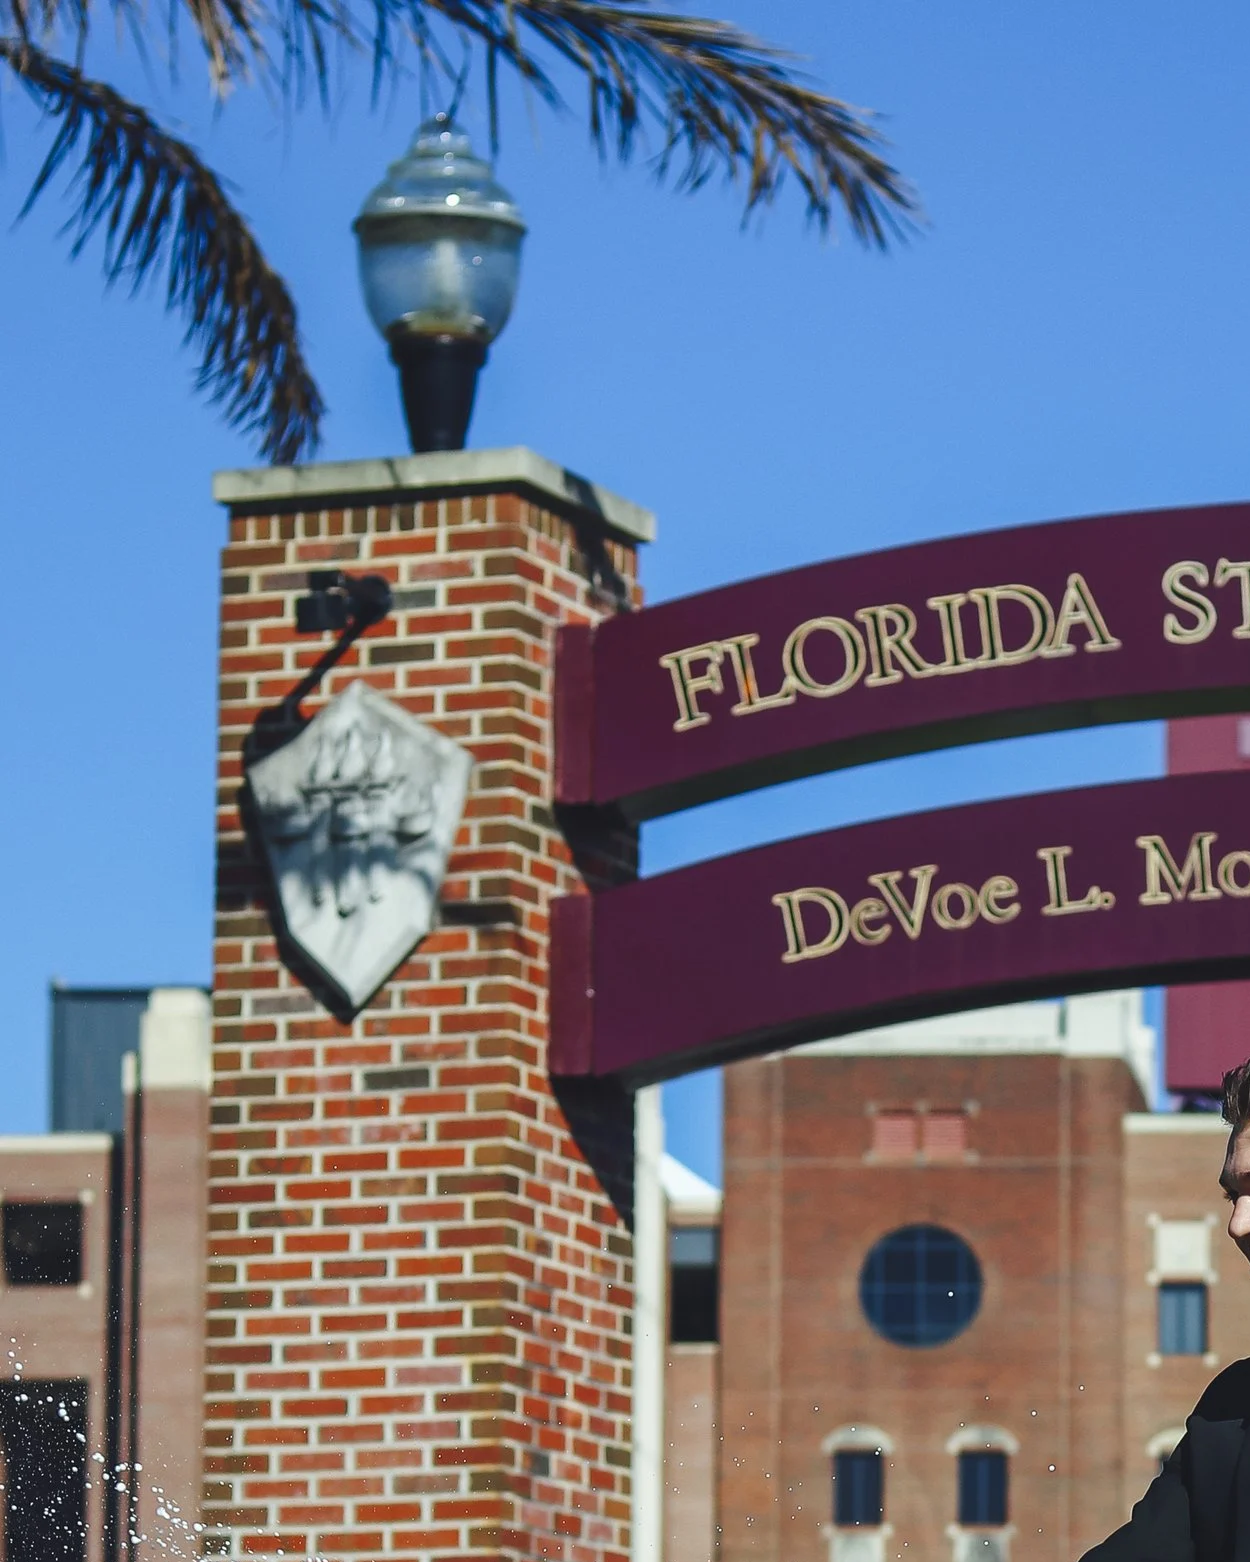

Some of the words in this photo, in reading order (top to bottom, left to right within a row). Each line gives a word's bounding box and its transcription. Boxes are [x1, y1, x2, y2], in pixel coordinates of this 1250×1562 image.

[660, 573, 1121, 731] FLORIDA
[772, 864, 1020, 964] DeVoe
[1037, 846, 1115, 916] L.
